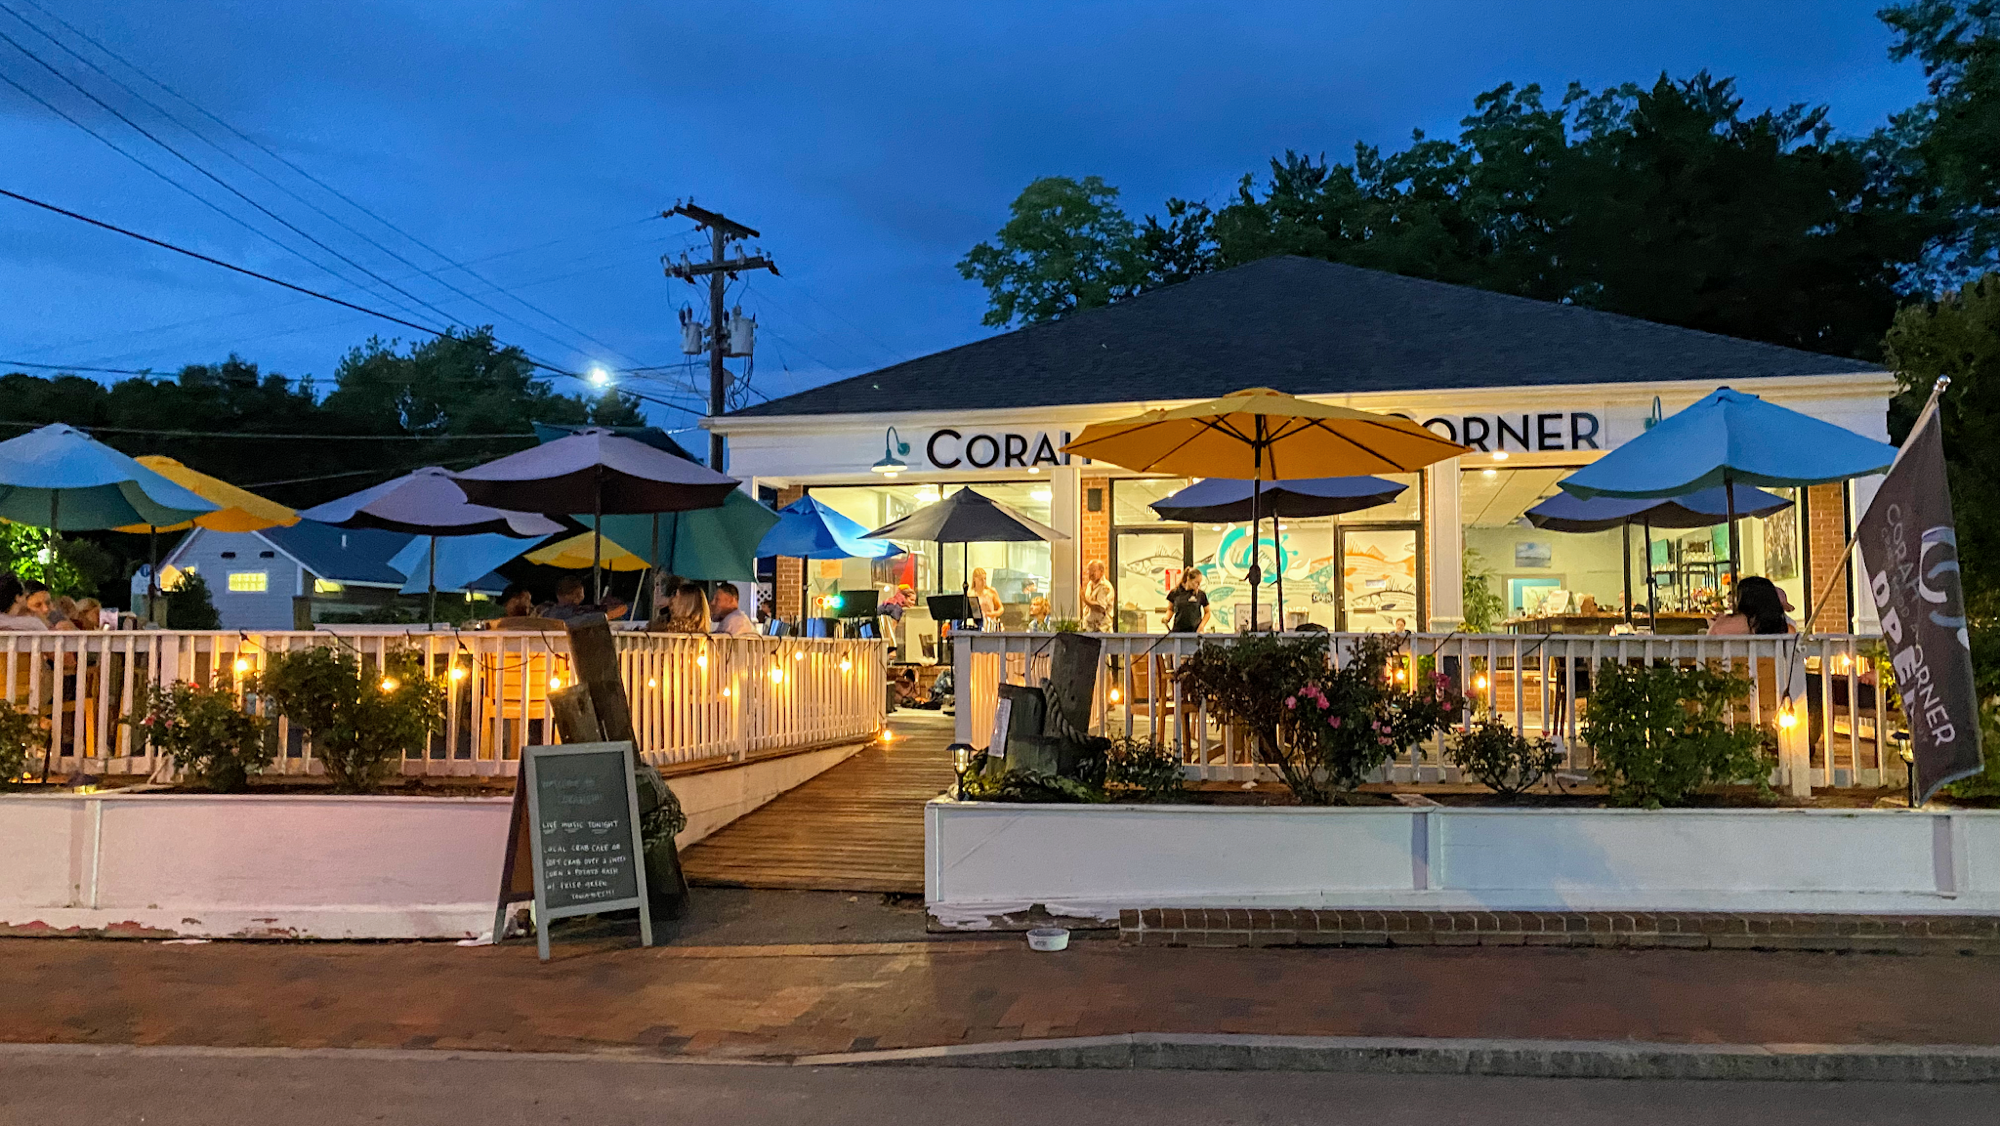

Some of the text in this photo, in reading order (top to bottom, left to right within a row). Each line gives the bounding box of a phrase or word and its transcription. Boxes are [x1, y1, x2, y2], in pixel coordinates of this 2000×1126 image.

[1388, 412, 1599, 452] ORNER
[561, 821, 584, 829] MUSIC
[587, 820, 619, 828] TONIGHT
[543, 845, 567, 854] LOCAL
[571, 844, 590, 852] CRAB
[592, 844, 610, 853] CAKE
[545, 857, 562, 867] SOFT
[563, 858, 582, 867] CRAB
[545, 870, 564, 879] CORN
[574, 868, 598, 876] POTATO
